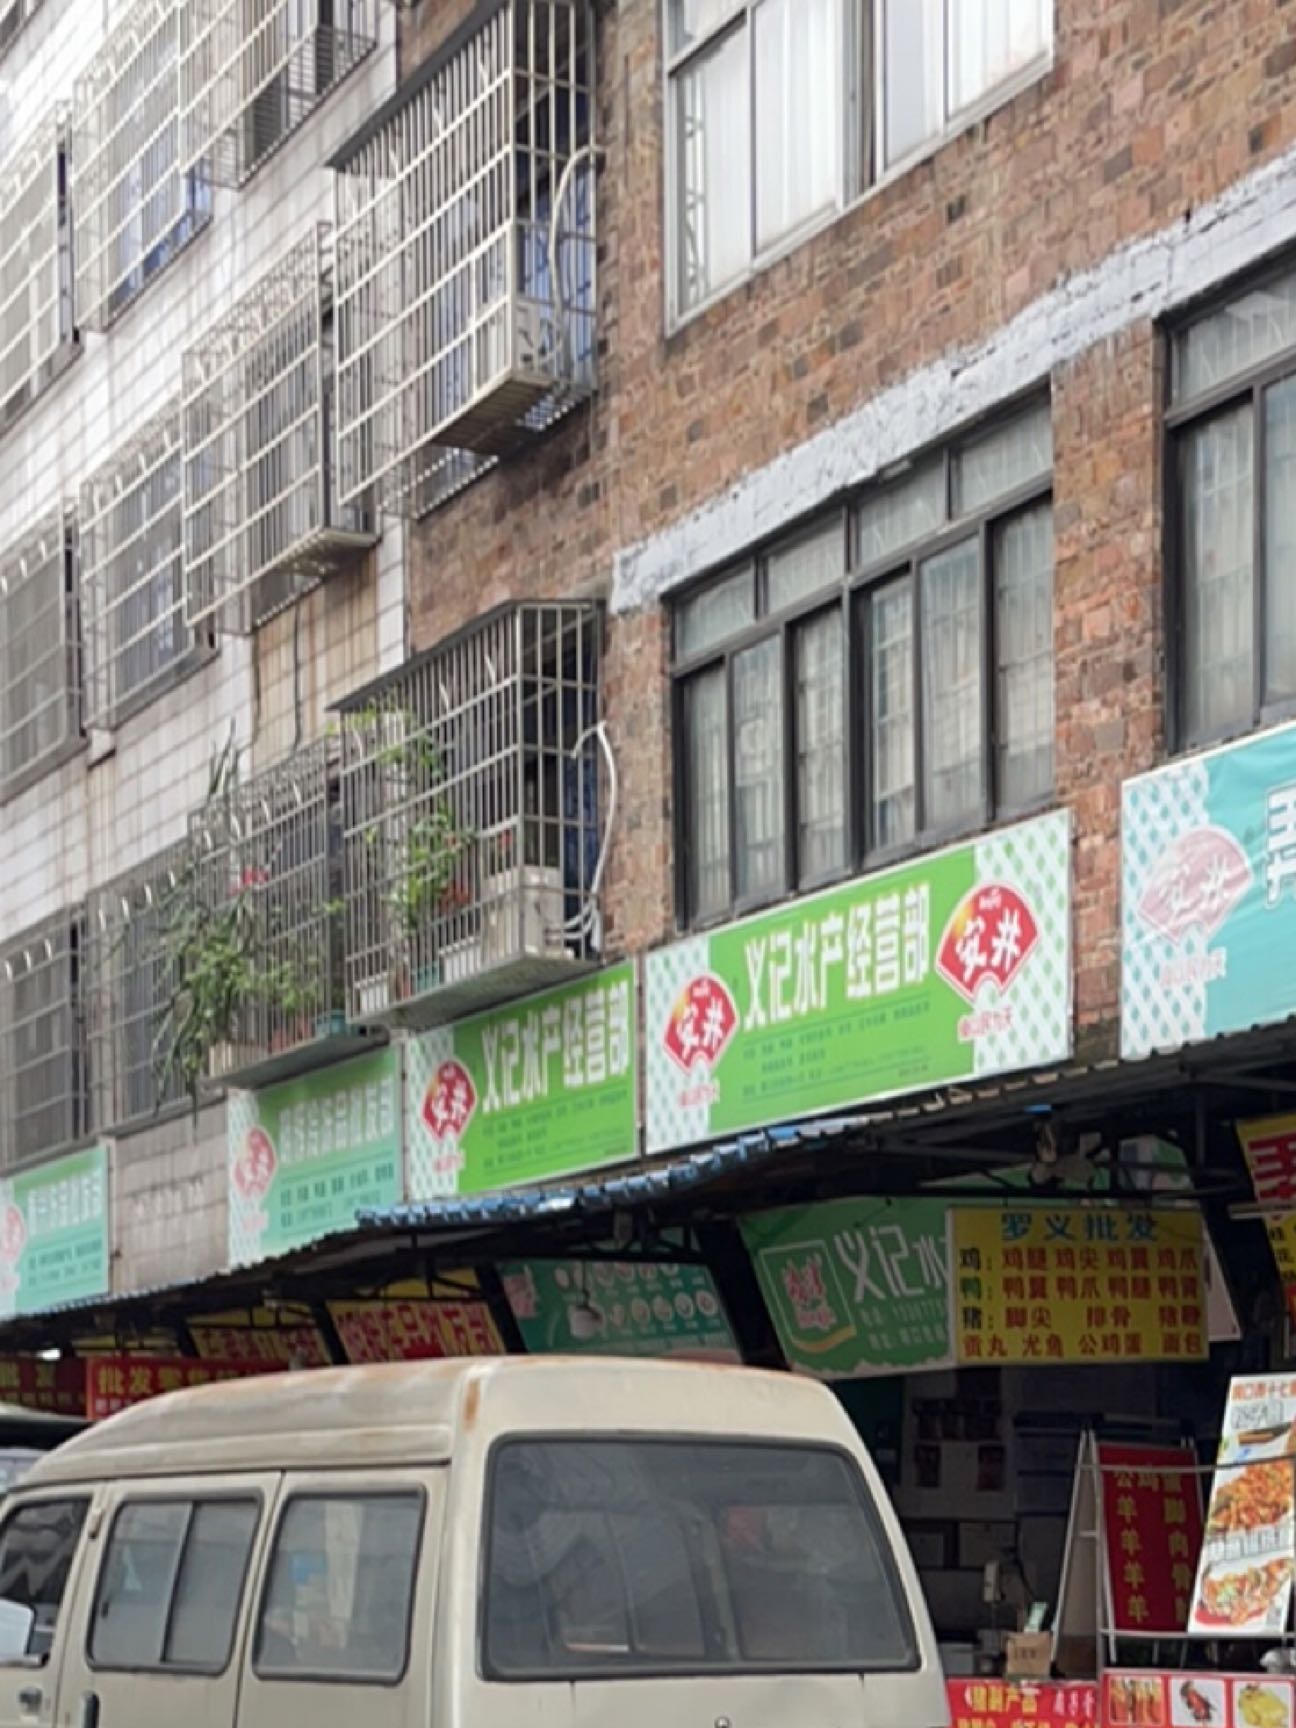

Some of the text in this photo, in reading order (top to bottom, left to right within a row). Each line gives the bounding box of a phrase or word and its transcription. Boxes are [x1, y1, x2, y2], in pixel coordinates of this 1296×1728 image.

[743, 884, 932, 1030] 义记水产经营部
[955, 911, 1025, 981] 安井
[481, 980, 629, 1113] 义记水产经营部
[675, 997, 724, 1056] 安井
[833, 1224, 947, 1303] 义记水
